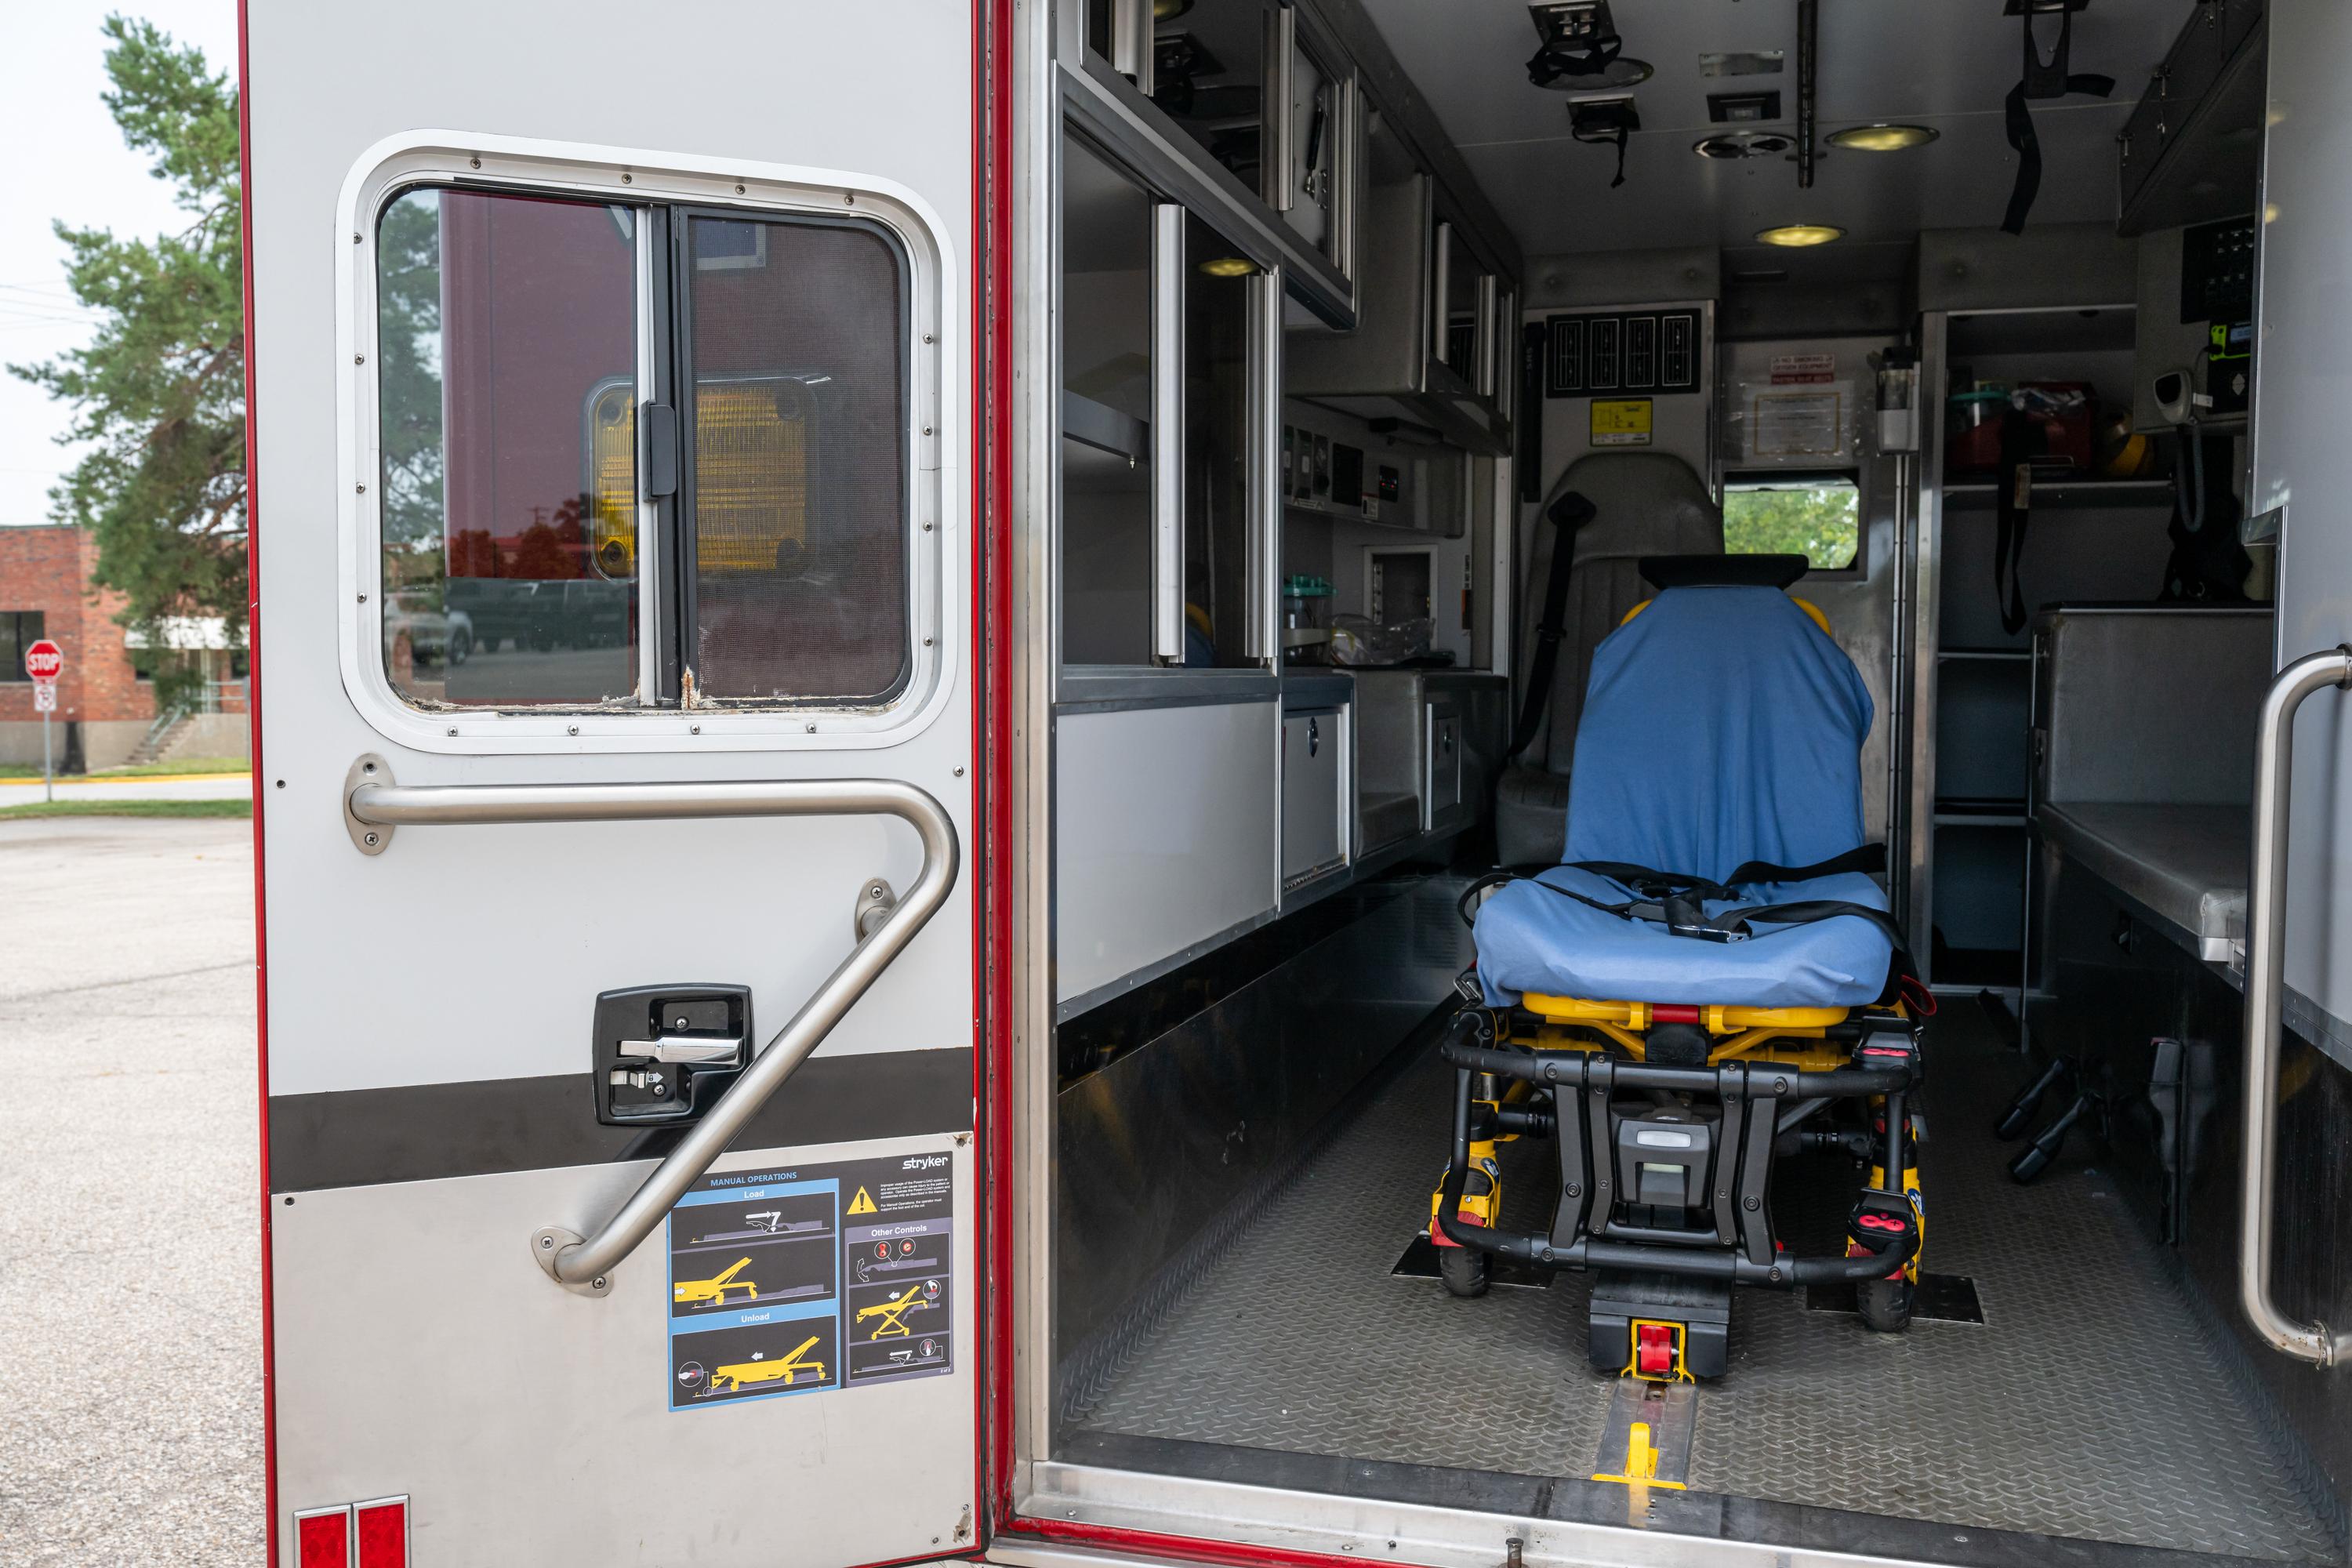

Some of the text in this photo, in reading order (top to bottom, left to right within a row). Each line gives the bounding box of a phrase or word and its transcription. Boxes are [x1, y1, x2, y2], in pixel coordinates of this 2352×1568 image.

[29, 653, 60, 671] STOP
[902, 1156, 949, 1170] stryker
[710, 1171, 797, 1187] MANUAL OPERATIONS
[744, 1189, 764, 1199] Load
[895, 1225, 927, 1235] Controls
[741, 1312, 770, 1323] Unload
